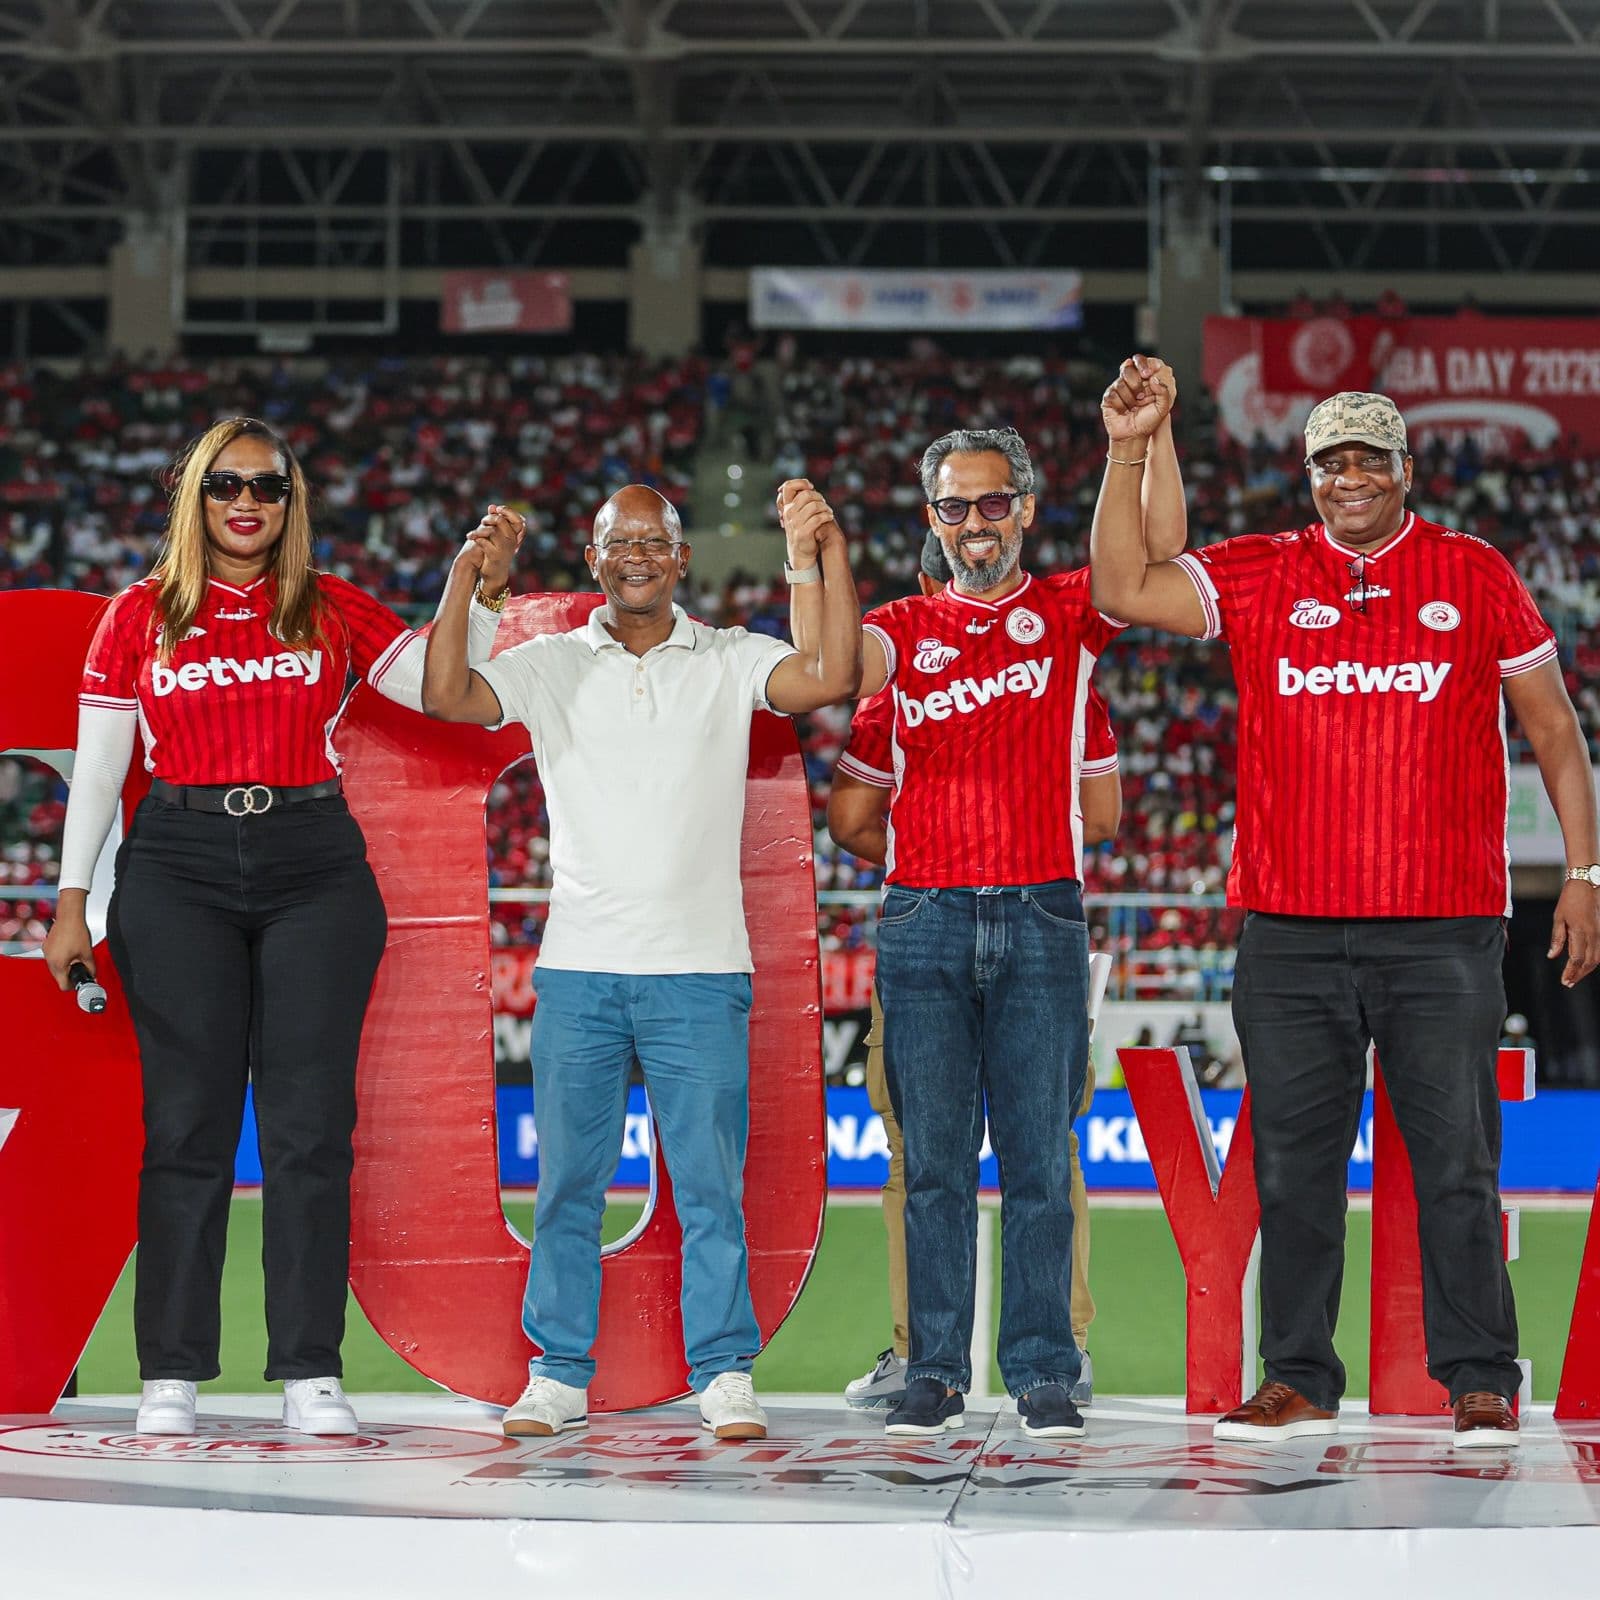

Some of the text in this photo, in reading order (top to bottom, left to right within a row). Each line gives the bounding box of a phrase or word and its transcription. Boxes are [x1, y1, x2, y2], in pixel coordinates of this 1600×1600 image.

[1446, 347, 1515, 392] DAY
[1295, 610, 1332, 626] Cola
[151, 650, 322, 697] betway
[919, 650, 953, 669] Cola
[1278, 657, 1452, 703] betway
[899, 657, 1053, 728] betway
[448, 1480, 606, 1489] MAIN
[806, 1485, 1112, 1497] SPONSOR
